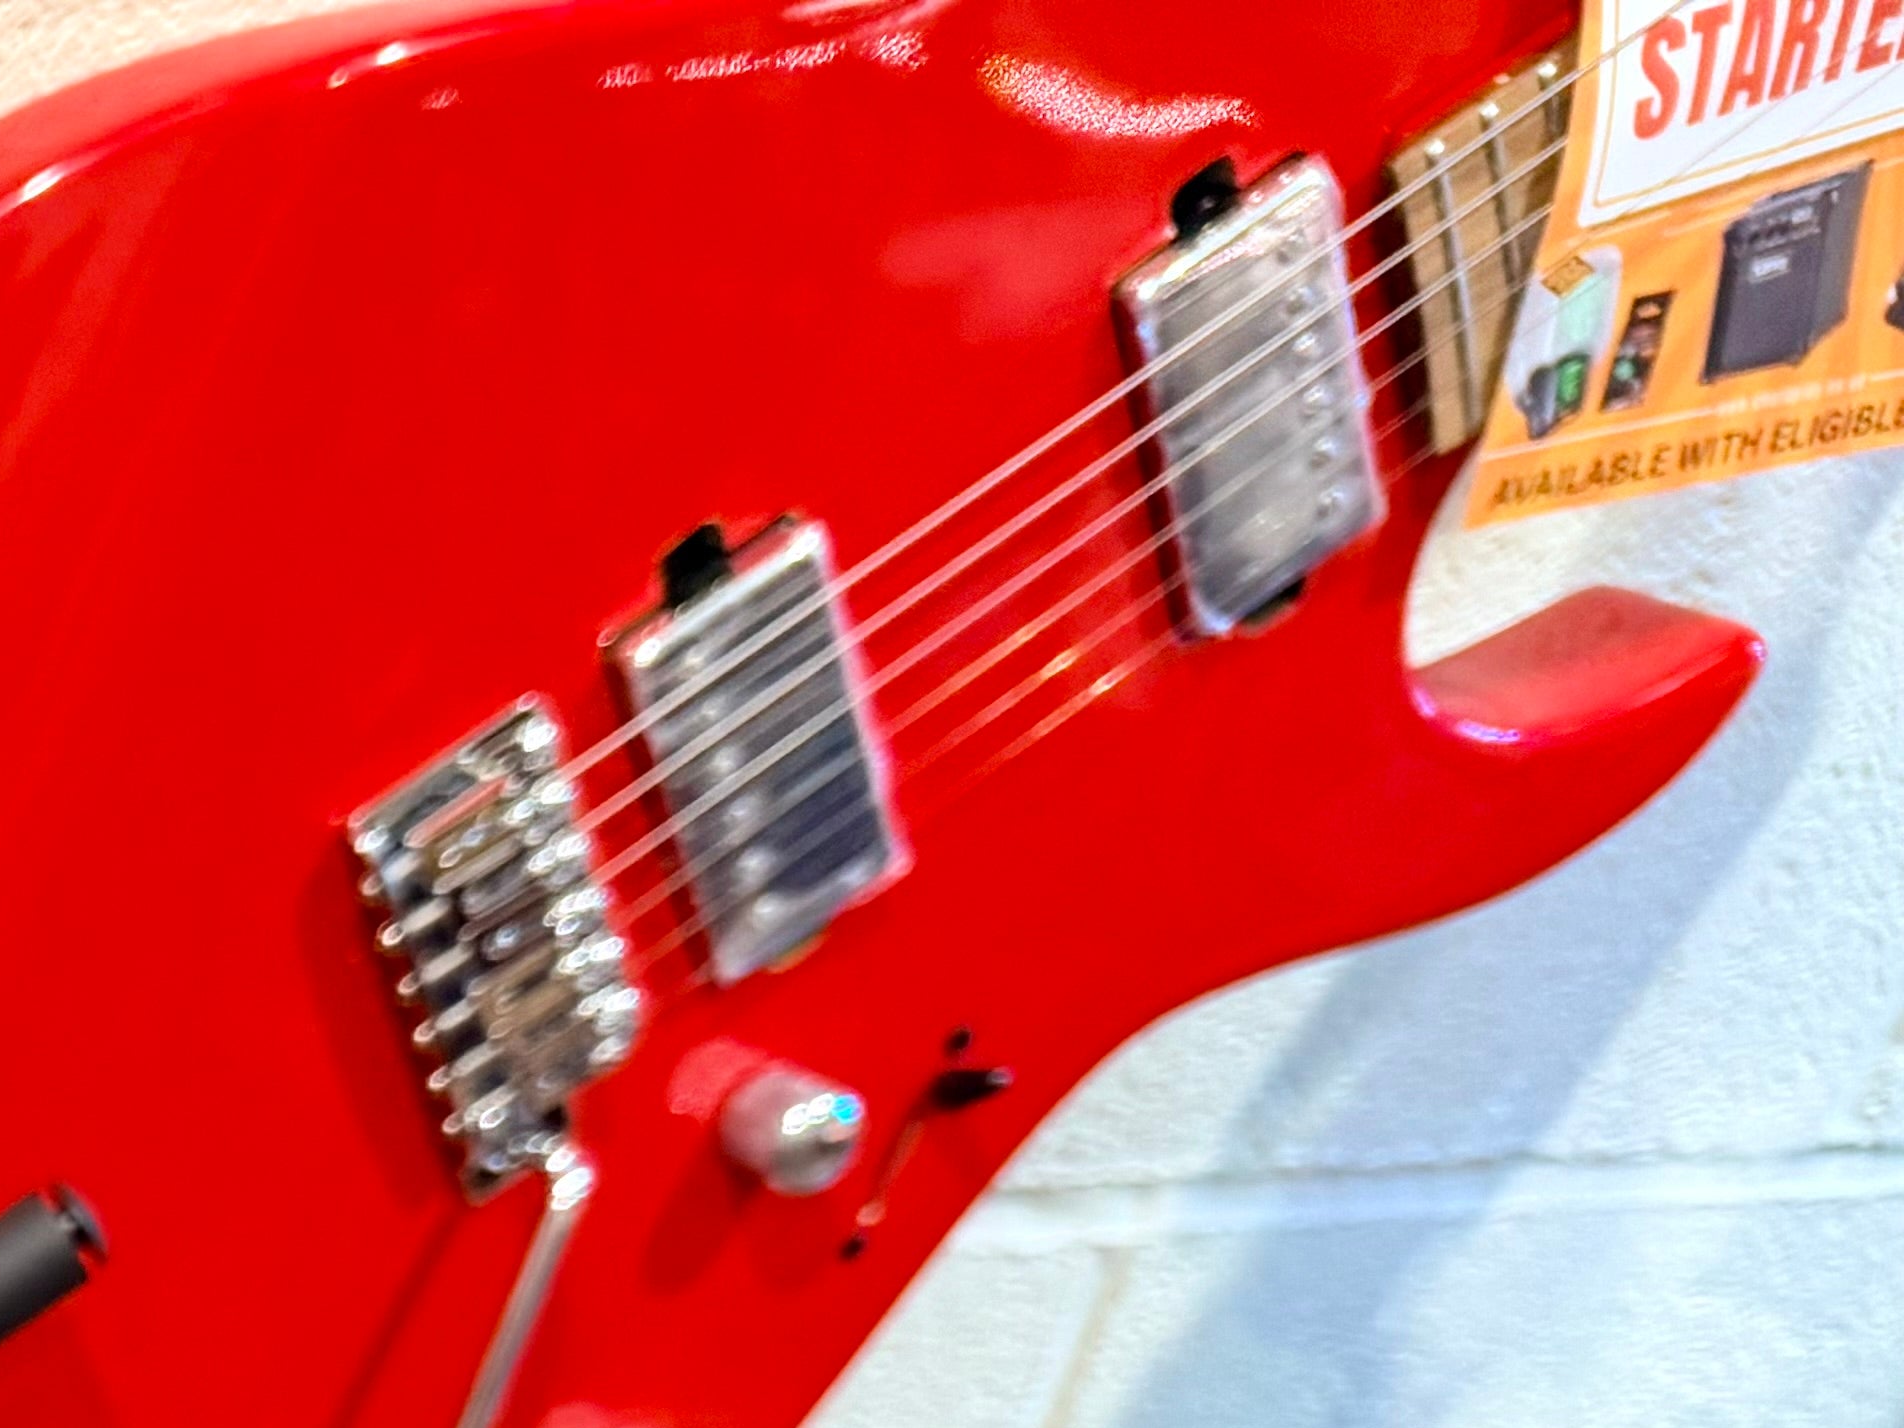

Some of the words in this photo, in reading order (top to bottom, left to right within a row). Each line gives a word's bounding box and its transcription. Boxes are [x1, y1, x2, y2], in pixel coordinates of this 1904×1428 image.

[1633, 0, 1904, 140] STARTE
[1493, 443, 1671, 504] AVAILABLE
[1678, 424, 1763, 471] WITH
